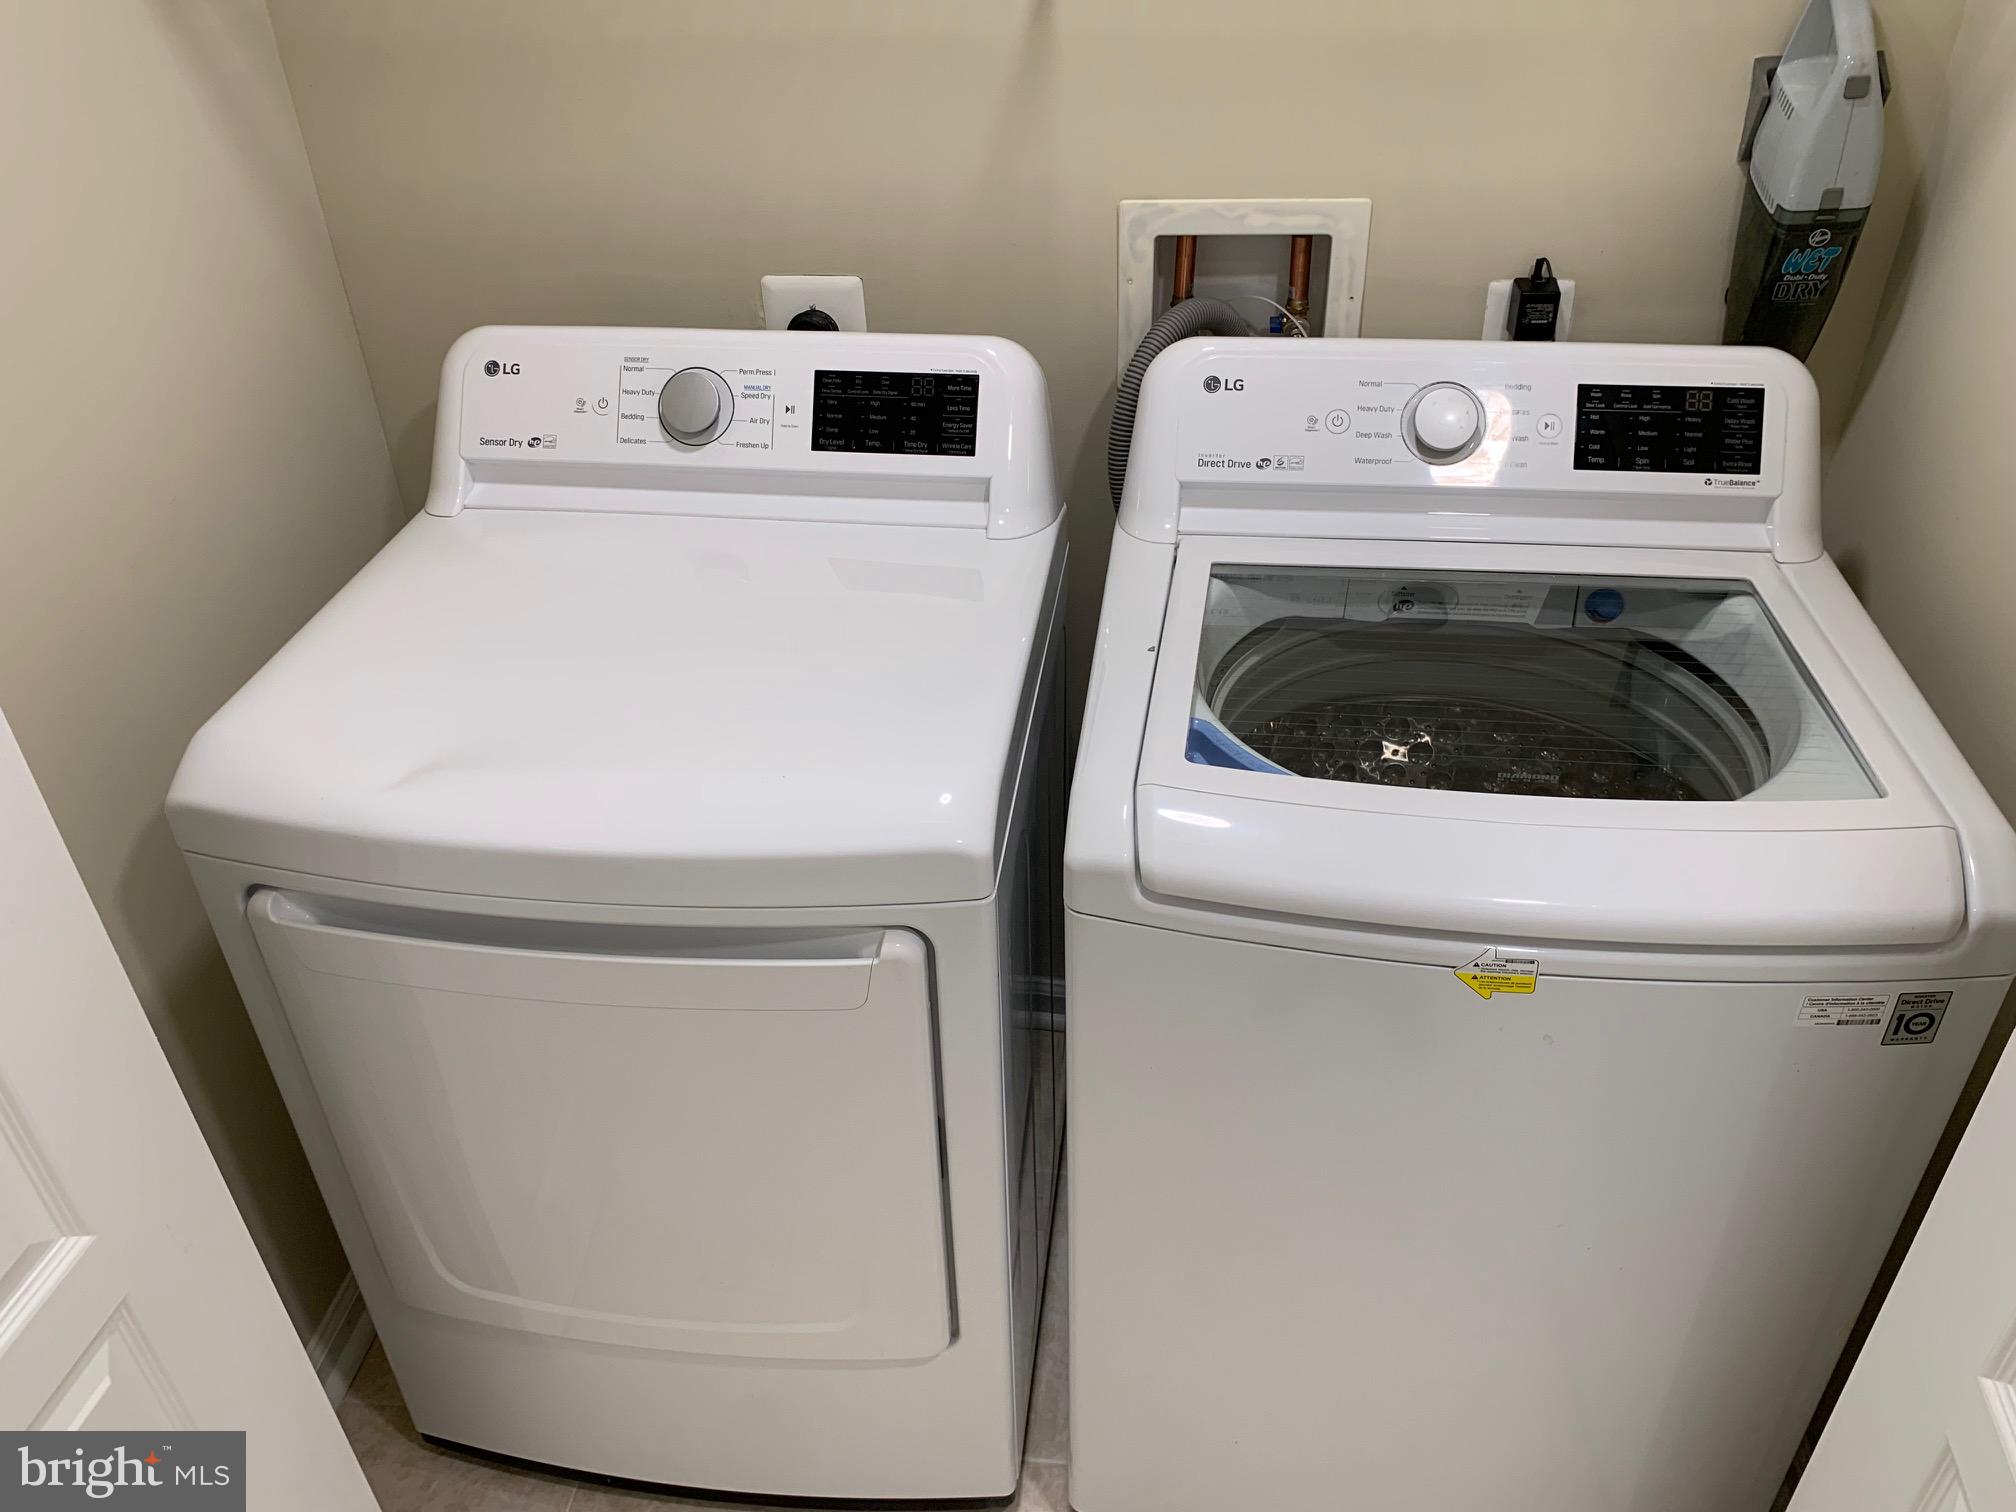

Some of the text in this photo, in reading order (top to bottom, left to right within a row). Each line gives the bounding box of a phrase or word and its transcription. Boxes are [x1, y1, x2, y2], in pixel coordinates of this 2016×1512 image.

[1781, 246, 1843, 274] WET
[1771, 280, 1830, 301] DRY
[502, 362, 521, 375] LG
[1225, 378, 1245, 391] LG
[1358, 380, 1383, 388] Normal
[622, 389, 656, 397] Heavy Duty
[740, 392, 771, 401] Speed Dry
[1357, 405, 1395, 413] Heavy Duty
[620, 412, 645, 421] Bedding
[749, 417, 770, 426] Air Dry
[942, 421, 959, 430] Energy
[1355, 431, 1393, 440] Deep Wash
[479, 437, 524, 449] Sensor Dry
[619, 437, 647, 445] Delicates
[736, 441, 770, 450] Freshen Up
[819, 437, 845, 446] Dry Level
[904, 440, 929, 450] Time Dry
[1197, 458, 1253, 469] Direct Drive
[1353, 457, 1393, 466] Waterproof
[1635, 457, 1650, 465] Spin
[1682, 458, 1695, 466] Soil
[1900, 998, 1924, 1007] Direct
[1892, 1012, 1936, 1036] 10
